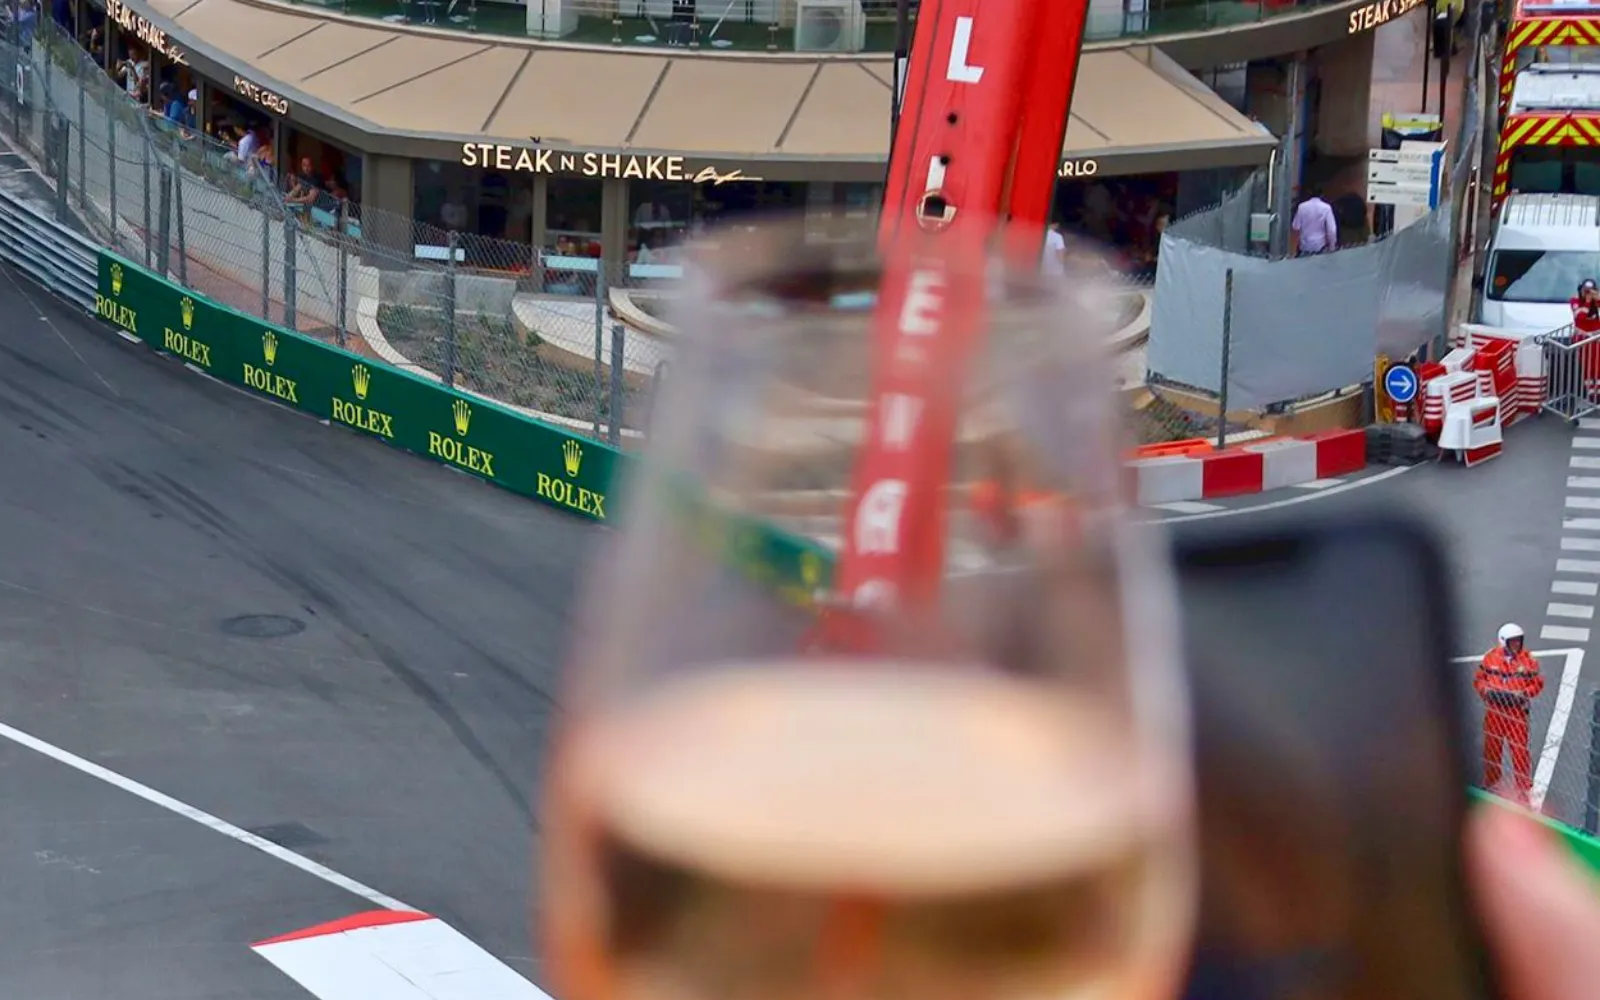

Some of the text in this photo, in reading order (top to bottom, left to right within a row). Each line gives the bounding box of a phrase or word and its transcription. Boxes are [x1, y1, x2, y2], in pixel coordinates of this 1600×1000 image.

[136, 16, 166, 54] SHAKE
[1348, 0, 1390, 34] STEAK
[233, 75, 289, 115] MONTE CARLO
[461, 143, 554, 174] STEAK
[560, 155, 575, 172] N
[582, 152, 684, 181] SHAKE
[95, 294, 138, 333] ROLEX
[164, 327, 211, 367] ROLEX
[243, 363, 298, 403] ROLEX
[331, 397, 394, 438] ROLEX
[428, 431, 495, 477] ROLEX
[536, 472, 606, 518] ROLEX
